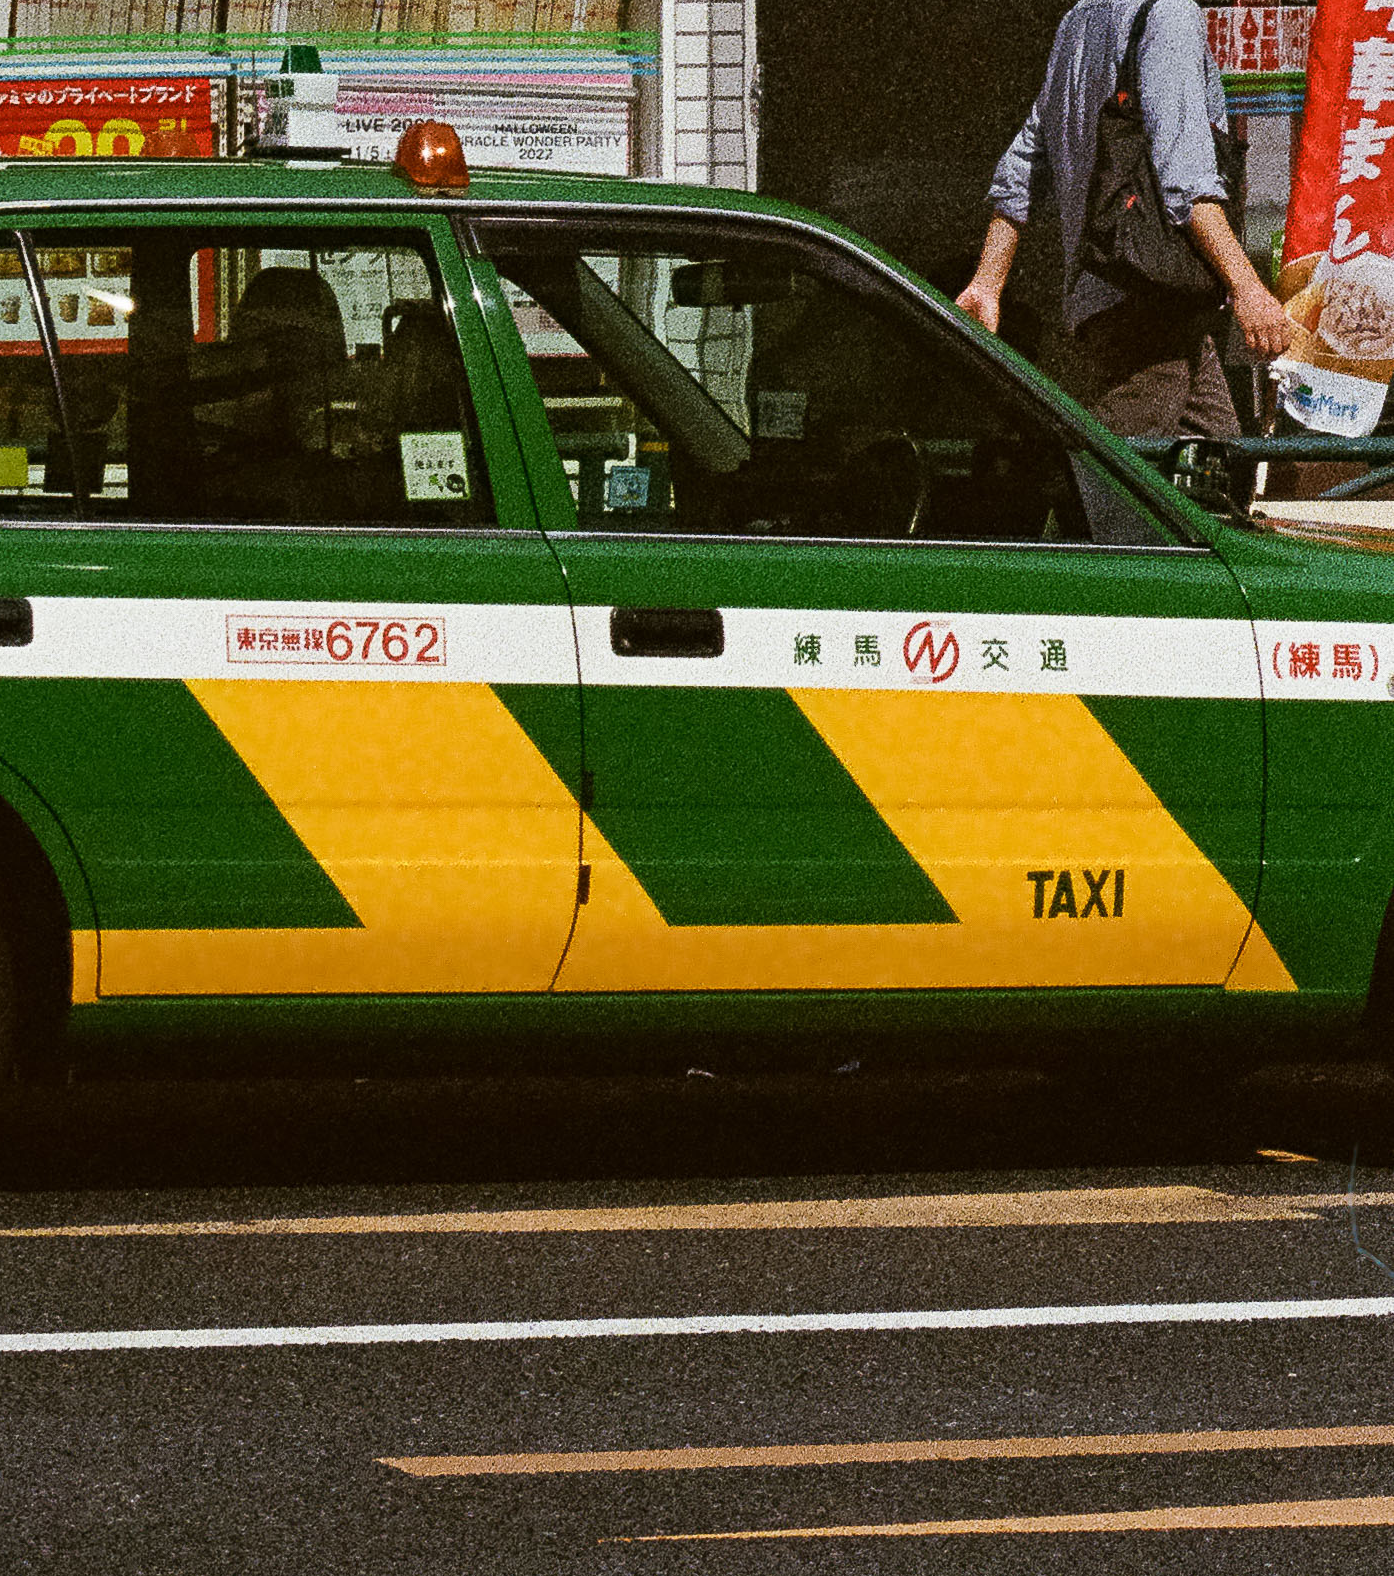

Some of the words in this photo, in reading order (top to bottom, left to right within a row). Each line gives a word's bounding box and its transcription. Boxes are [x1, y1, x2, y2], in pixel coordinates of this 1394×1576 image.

[494, 123, 578, 134] HALLOWEEN
[512, 135, 572, 147] WONDER
[575, 135, 622, 147] PARTY
[518, 148, 554, 160] 2022
[1026, 868, 1126, 920] TAXI
